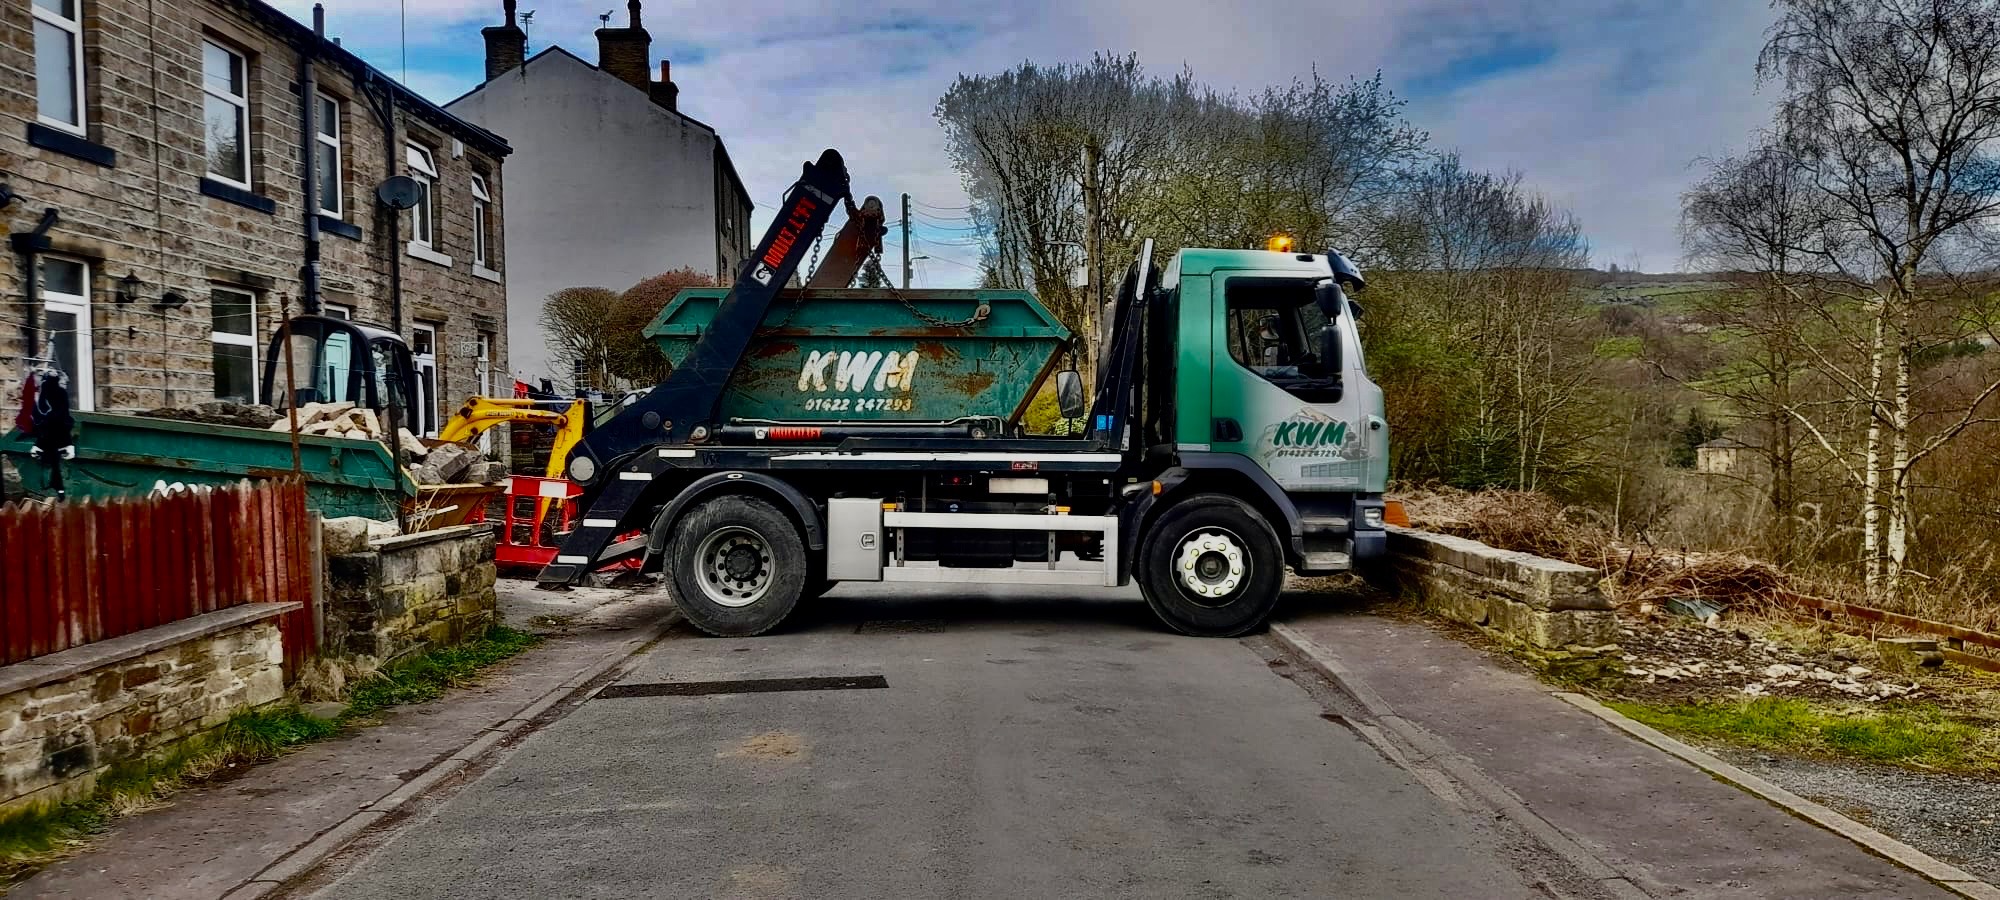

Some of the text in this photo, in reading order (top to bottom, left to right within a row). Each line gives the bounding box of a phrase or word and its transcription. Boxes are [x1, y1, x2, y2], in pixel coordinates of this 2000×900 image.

[763, 197, 816, 268] MULTLFT
[798, 350, 919, 392] KWM
[805, 398, 912, 411] 01422 247293
[1273, 421, 1347, 446] KWM
[1278, 450, 1342, 458] 01422 247293
